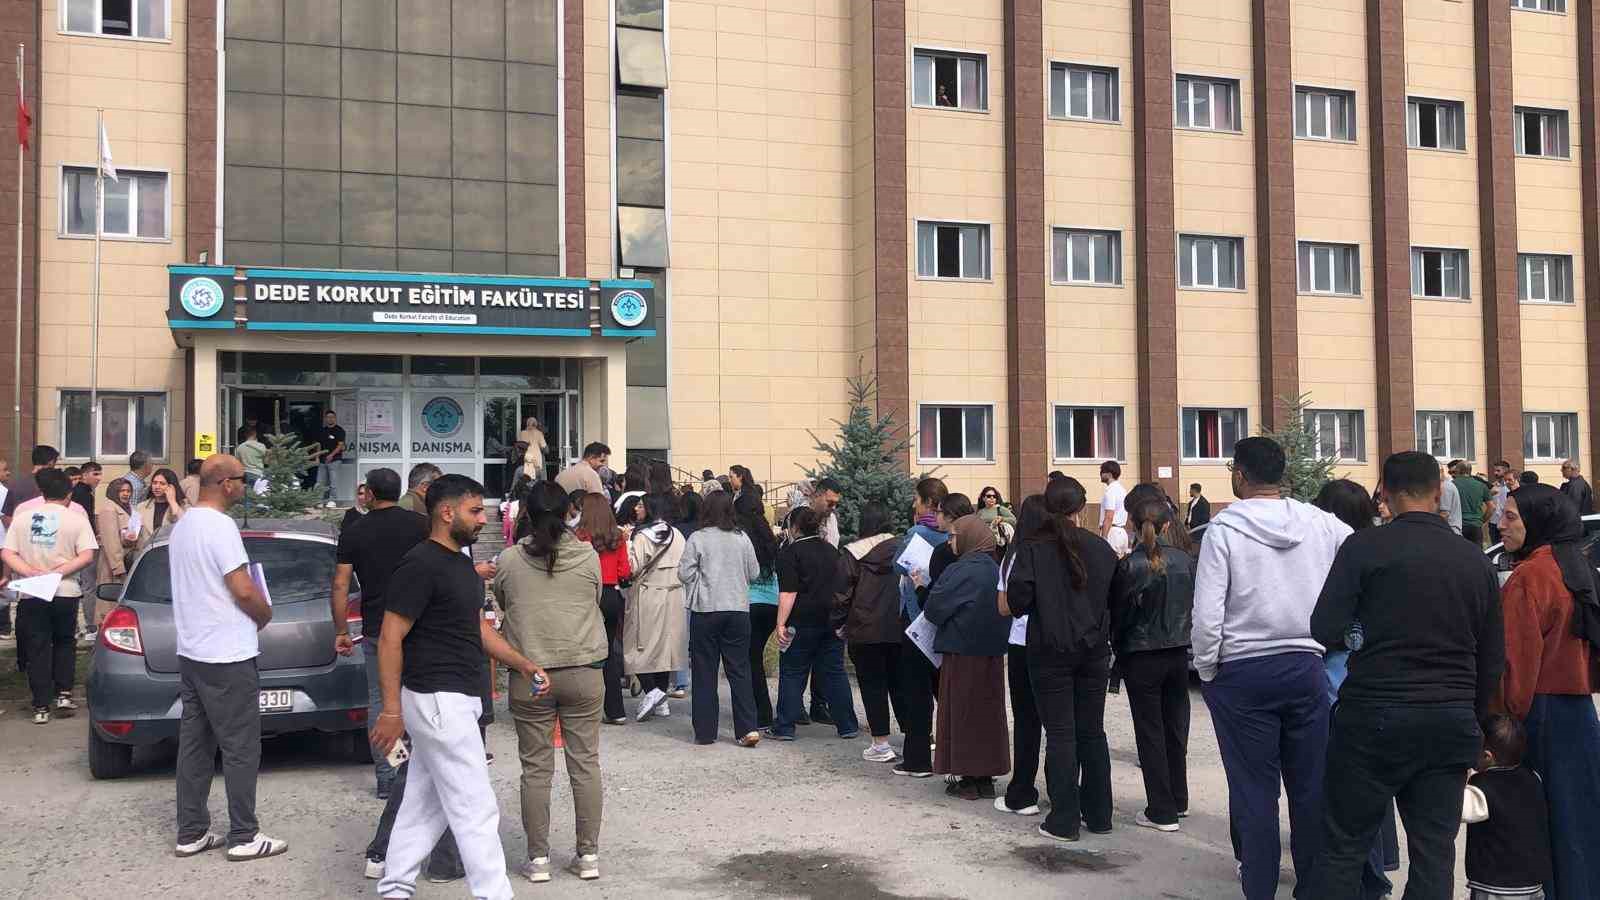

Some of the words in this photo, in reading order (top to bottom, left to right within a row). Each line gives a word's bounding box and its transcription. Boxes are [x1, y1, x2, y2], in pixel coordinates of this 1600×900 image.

[254, 283, 310, 301] DEDE
[316, 285, 402, 304] KORKUT
[408, 284, 475, 306] EĞİTİM
[481, 288, 584, 309] FAKÜLTESİ
[344, 441, 401, 454] ANIŞMA
[412, 441, 473, 454] DANIŞMA
